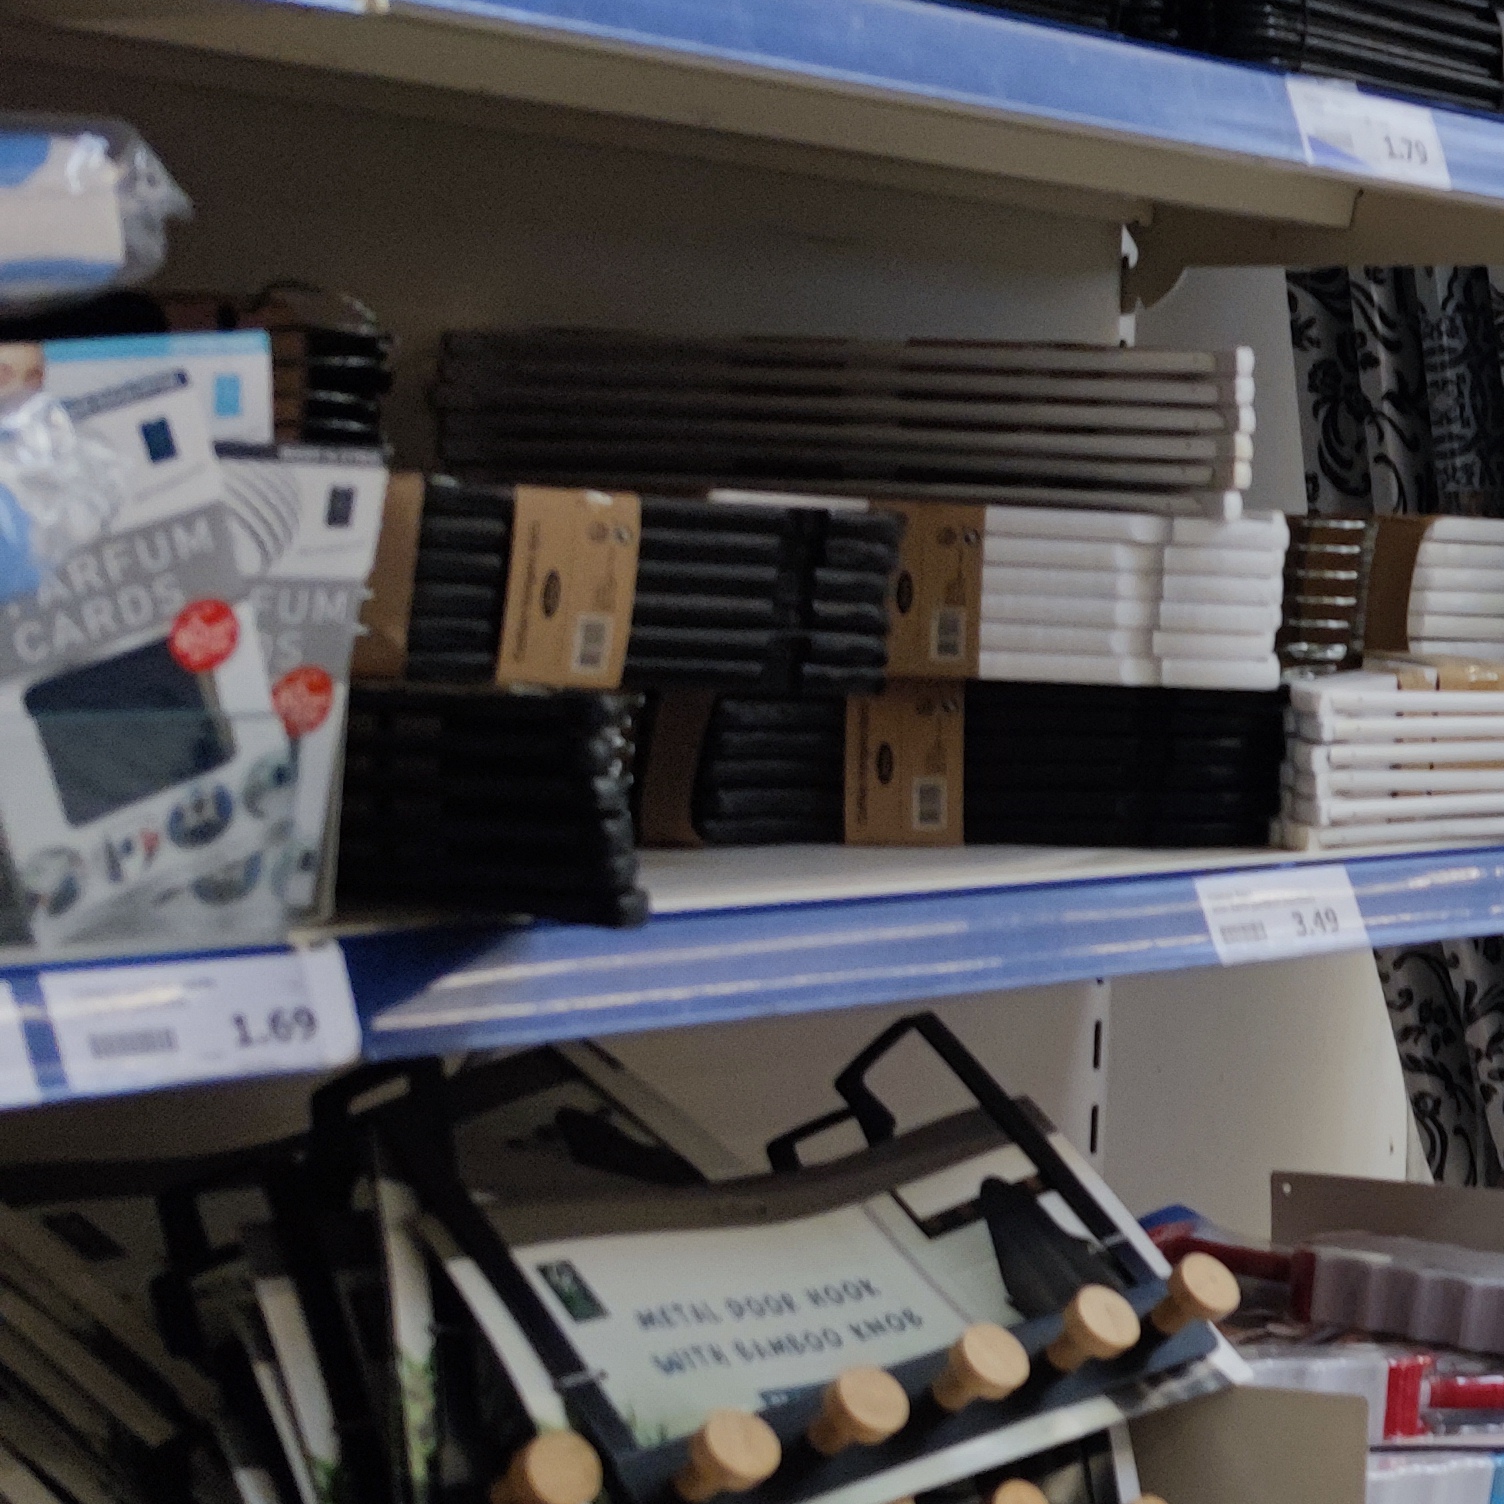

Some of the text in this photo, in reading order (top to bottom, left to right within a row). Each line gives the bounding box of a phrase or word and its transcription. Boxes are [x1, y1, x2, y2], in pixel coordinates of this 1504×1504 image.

[14, 573, 186, 664] CARDS
[1291, 907, 1340, 937] 3.49
[232, 1005, 318, 1046] 1.69
